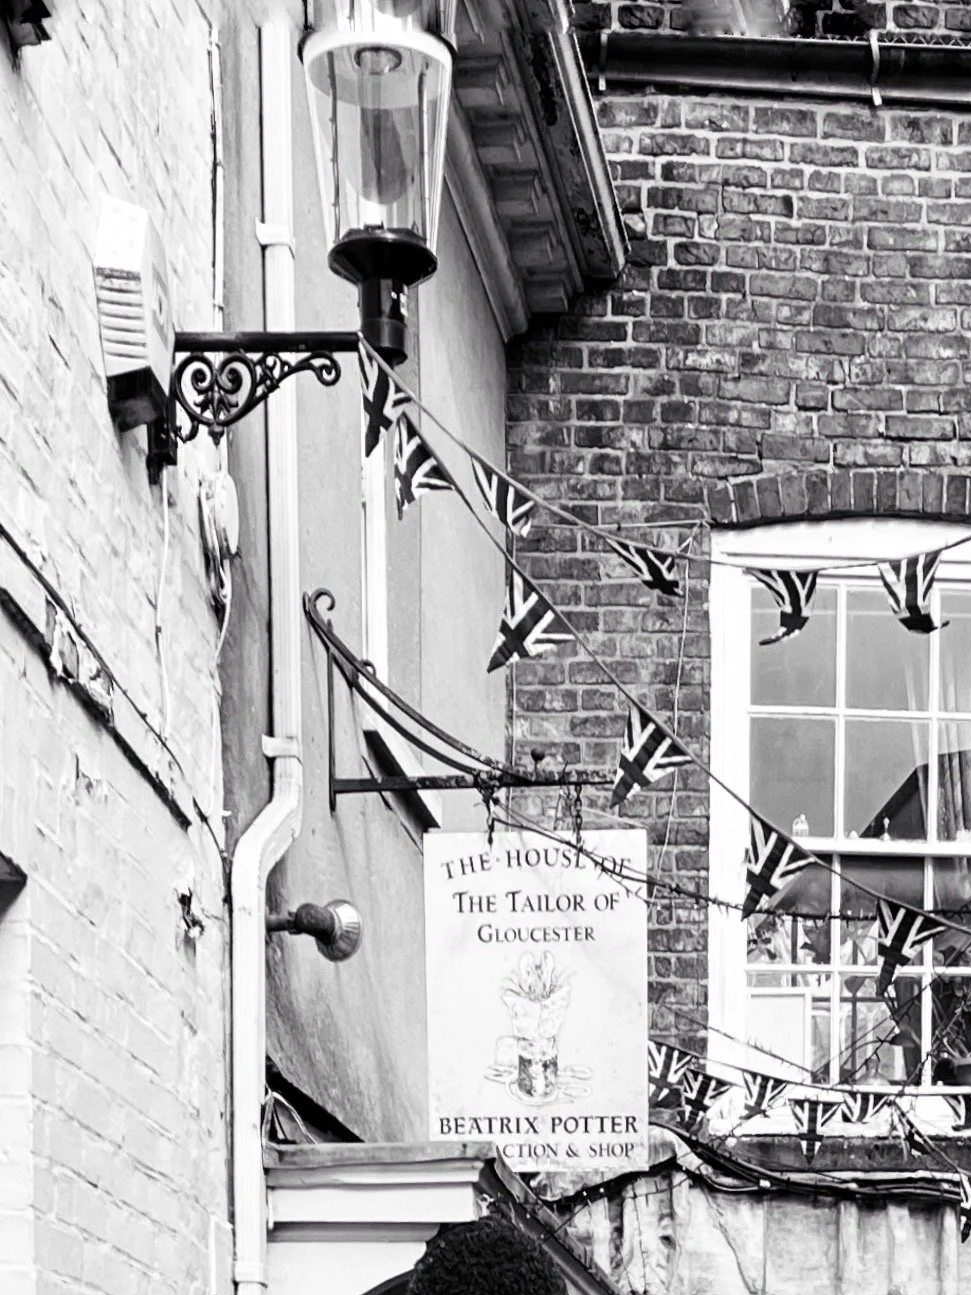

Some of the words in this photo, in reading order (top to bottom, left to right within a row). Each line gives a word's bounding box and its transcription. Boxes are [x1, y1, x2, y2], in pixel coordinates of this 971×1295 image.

[441, 852, 492, 880] THE
[506, 848, 586, 868] HOUSE
[452, 891, 497, 913] THE
[505, 890, 586, 912] TAILOR
[593, 892, 620, 911] OF
[477, 923, 596, 943] GLOUCESTER
[440, 1116, 539, 1134] BEATRIX
[551, 1115, 638, 1134] POTTER
[502, 1143, 558, 1158] CTION
[566, 1144, 581, 1158] &
[589, 1143, 635, 1158] SHOP
